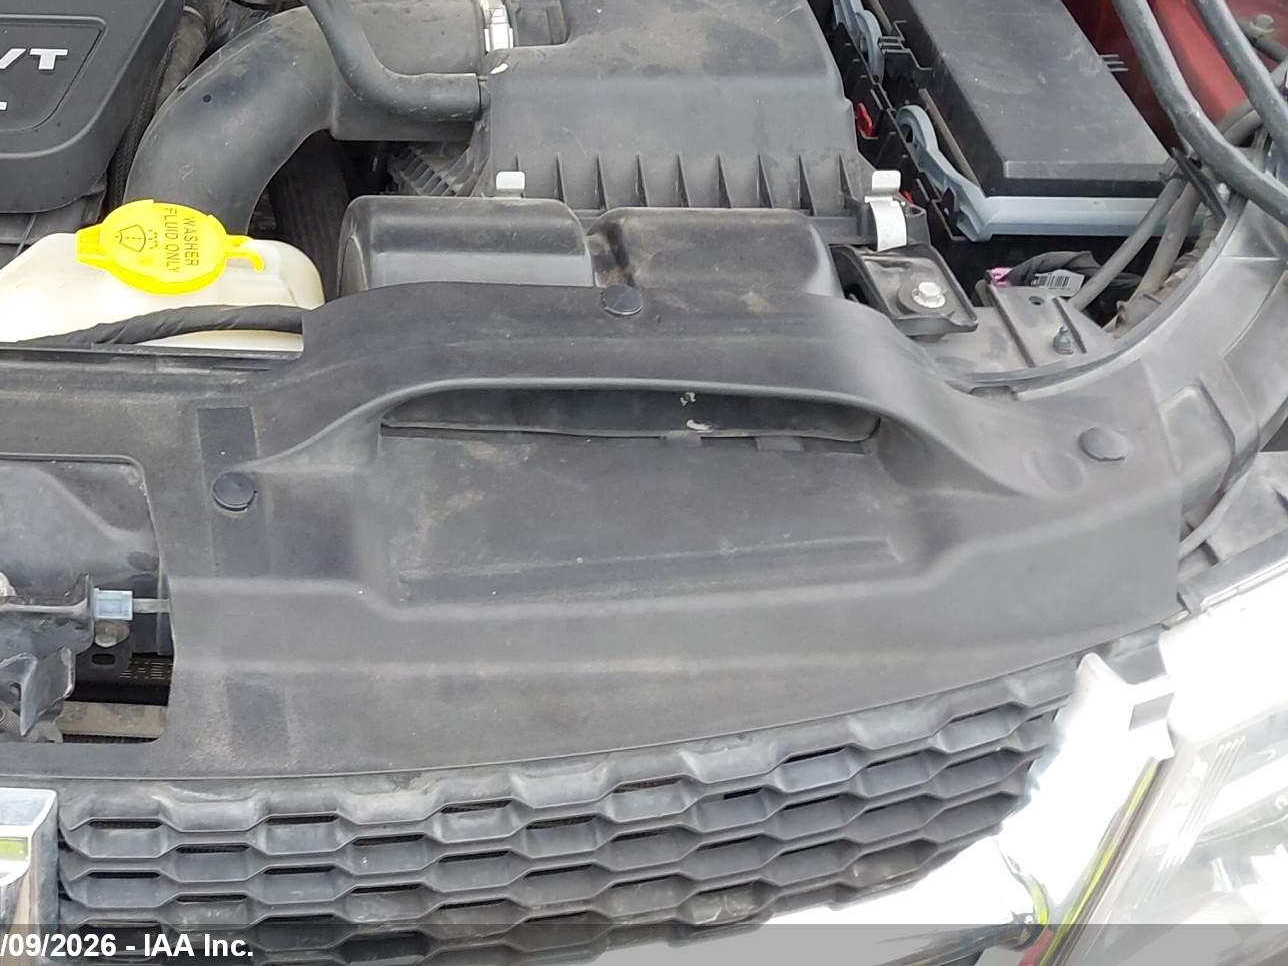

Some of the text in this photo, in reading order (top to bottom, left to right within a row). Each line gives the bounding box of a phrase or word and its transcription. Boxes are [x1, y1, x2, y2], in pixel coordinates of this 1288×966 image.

[164, 207, 182, 274] FLUID ONLY
[183, 216, 199, 267] WASHER
